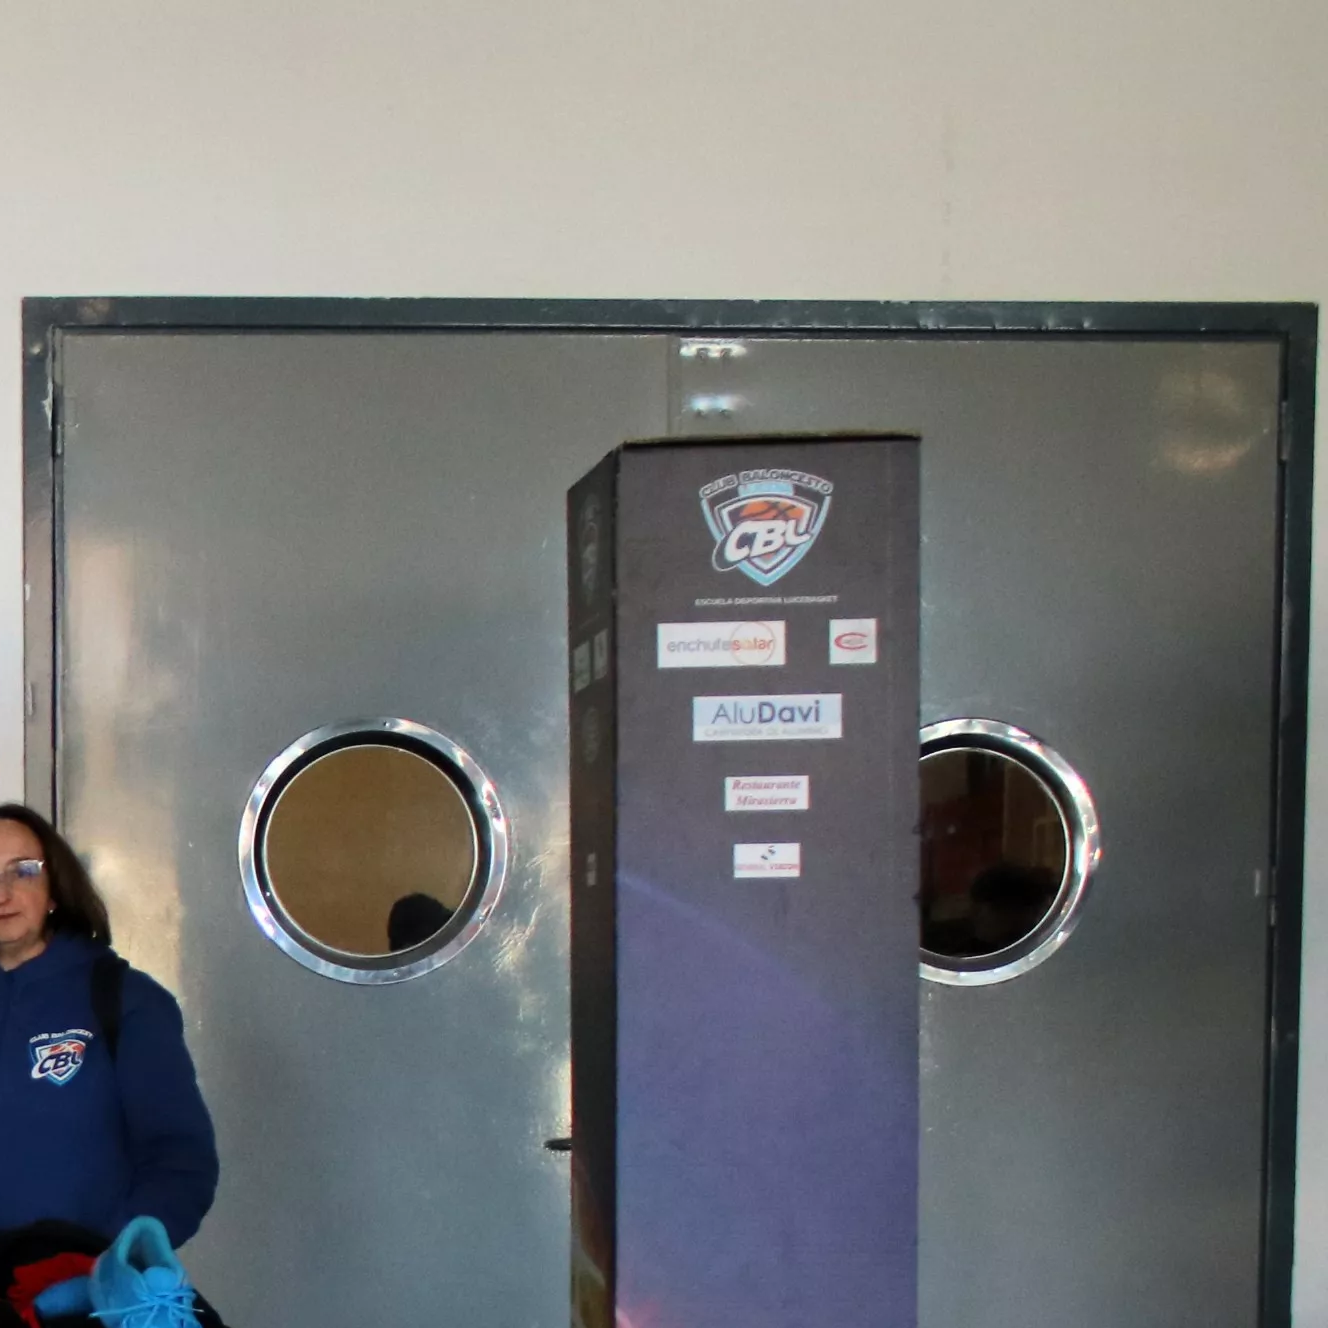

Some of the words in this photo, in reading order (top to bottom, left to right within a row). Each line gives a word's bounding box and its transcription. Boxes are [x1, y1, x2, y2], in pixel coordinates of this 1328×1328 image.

[723, 519, 812, 562] CBL
[711, 700, 821, 724] AluDavi
[38, 1051, 82, 1074] CBL
